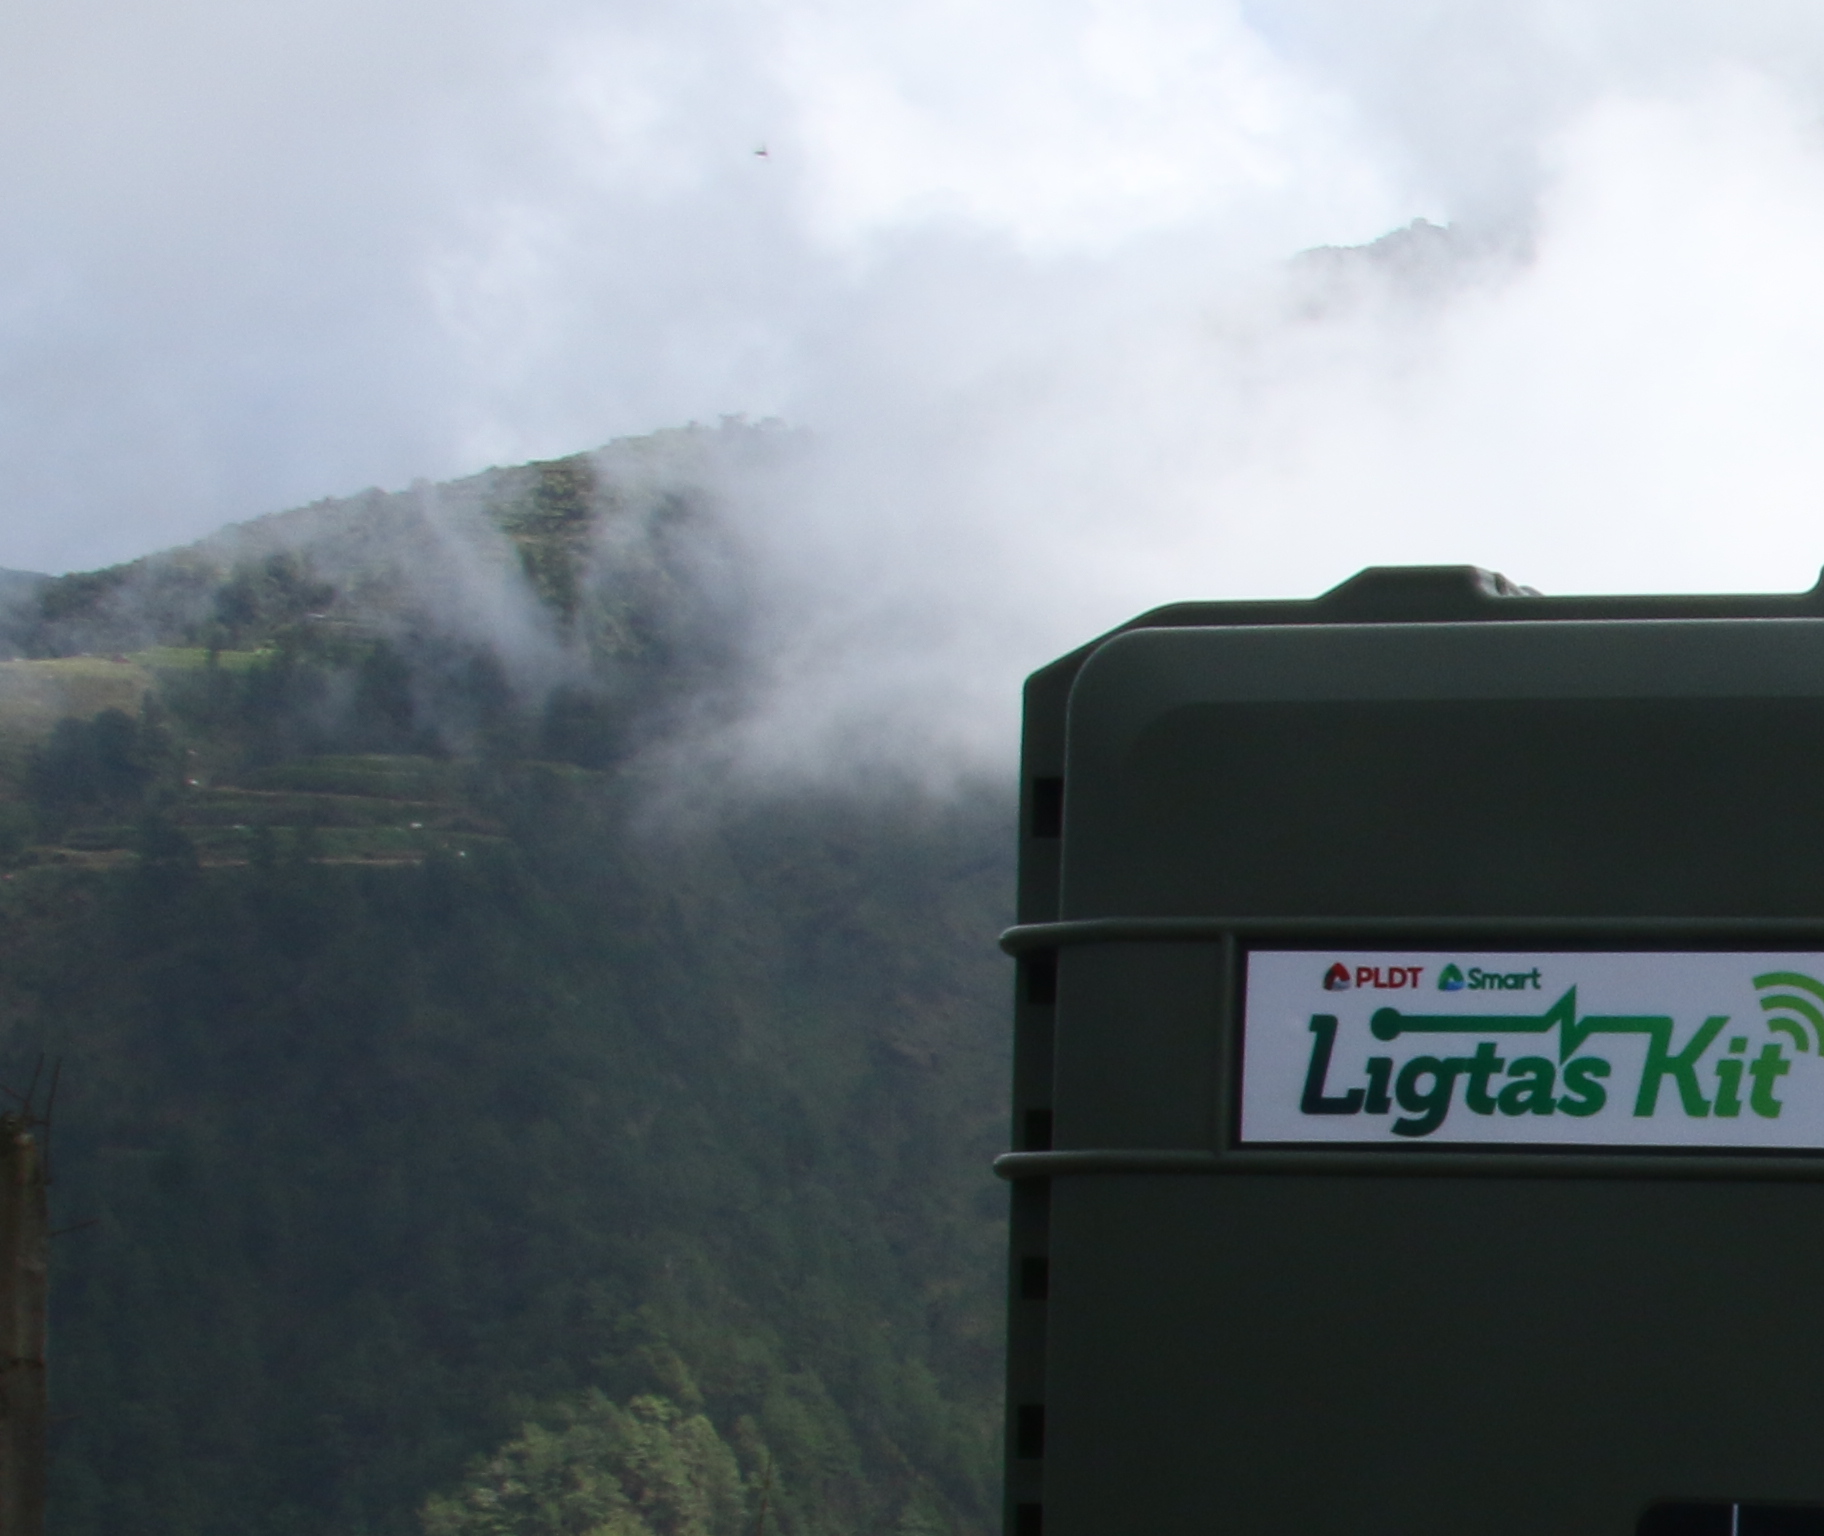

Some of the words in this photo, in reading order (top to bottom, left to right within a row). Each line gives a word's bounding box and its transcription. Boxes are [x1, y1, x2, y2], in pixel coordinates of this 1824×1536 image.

[1355, 966, 1424, 989] PLDT
[1468, 966, 1542, 991] Smart
[1300, 1008, 1612, 1138] Ligtas
[1632, 1015, 1793, 1119] Kit
